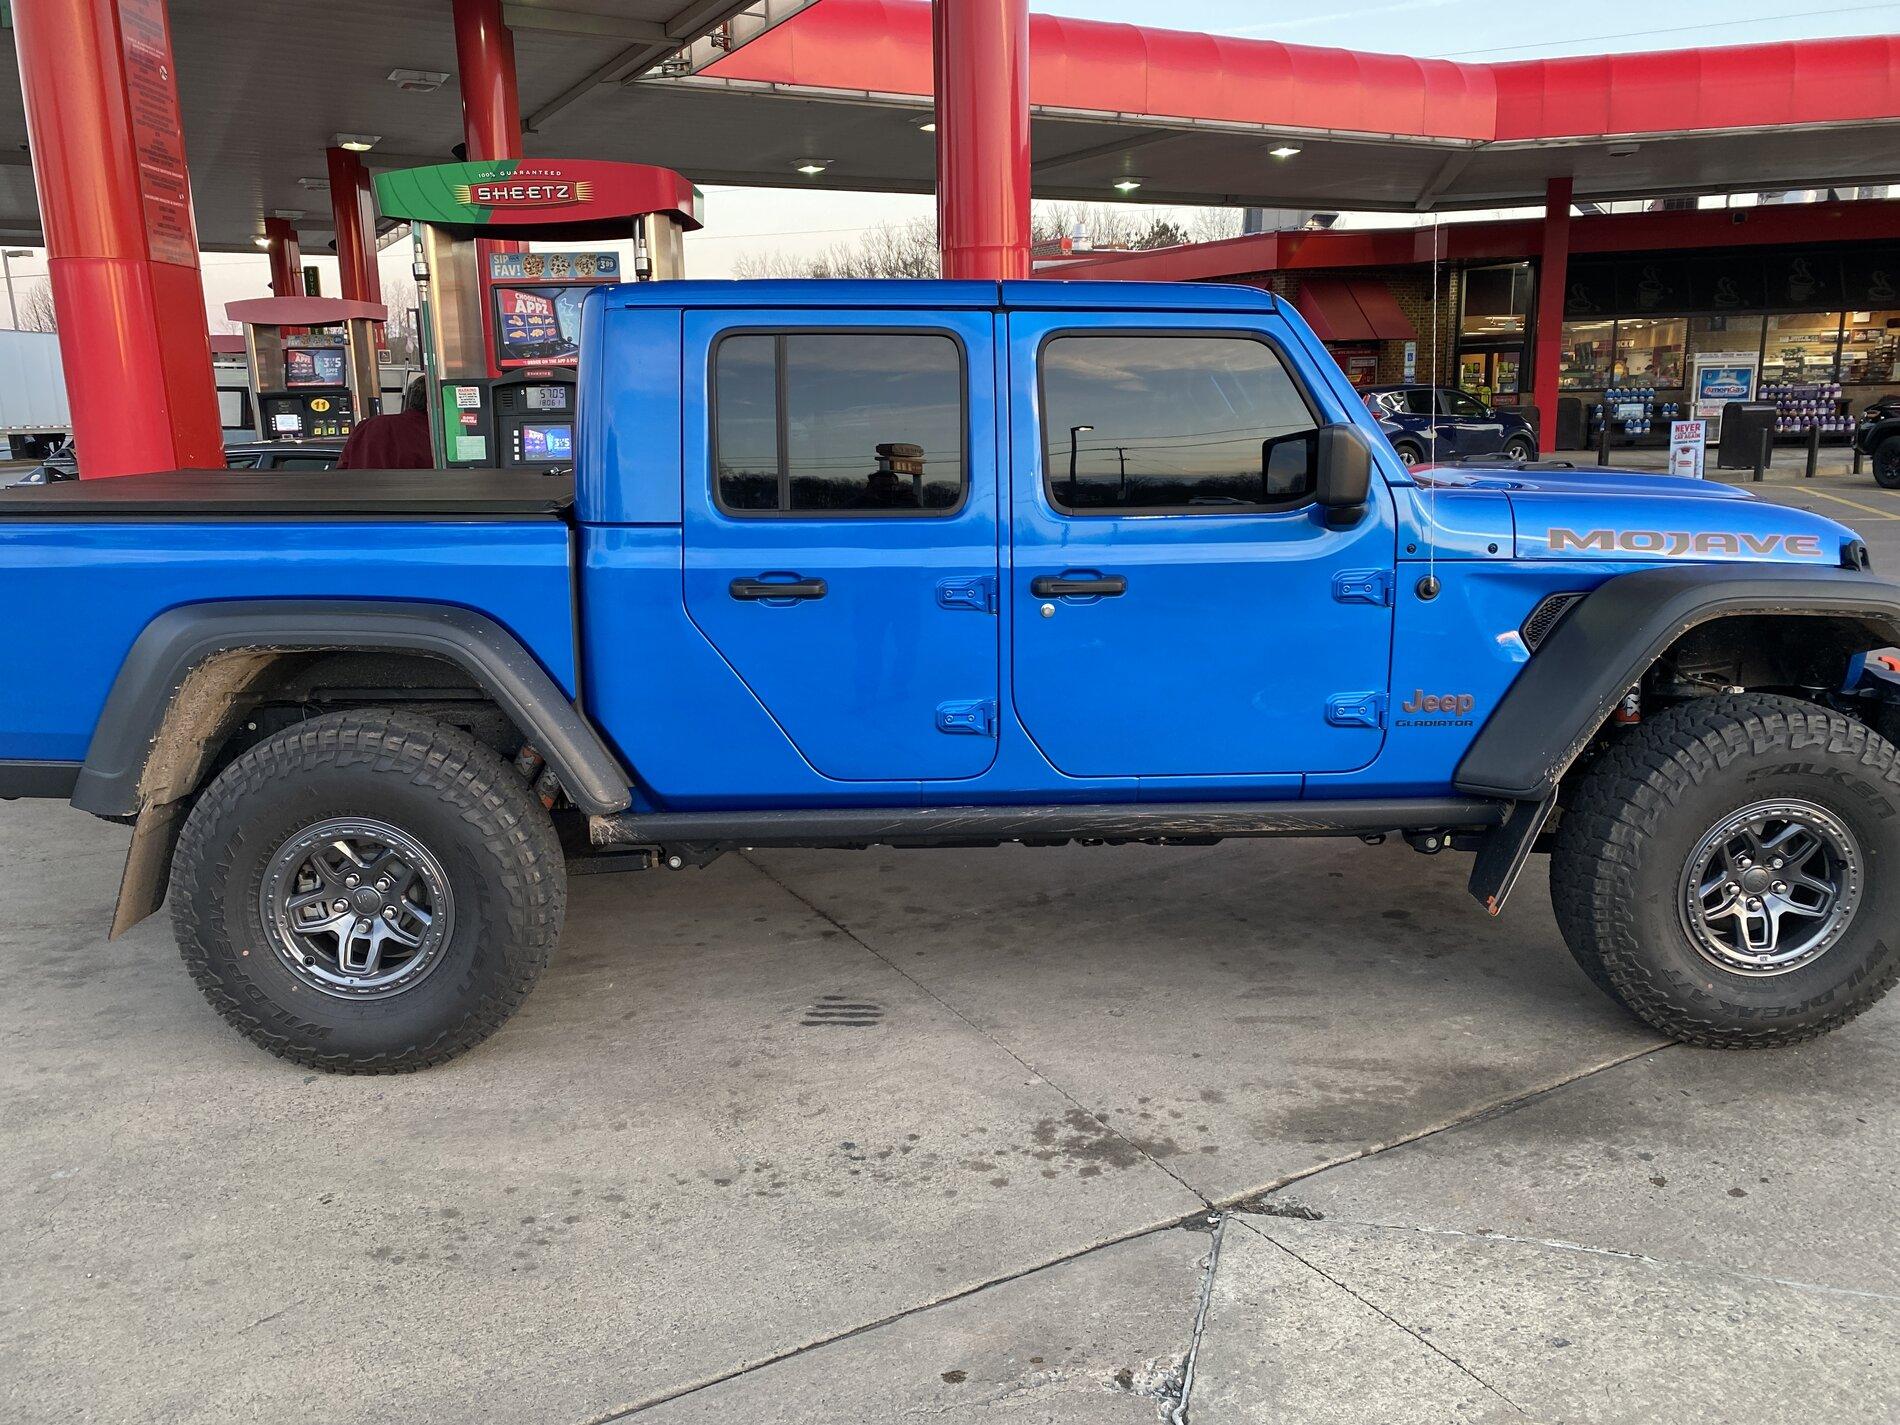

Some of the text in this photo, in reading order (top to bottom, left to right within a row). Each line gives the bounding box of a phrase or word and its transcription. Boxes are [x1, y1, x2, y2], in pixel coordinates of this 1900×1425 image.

[500, 169, 562, 177] GUARANTEED
[477, 185, 569, 200] SHEETZ
[493, 255, 508, 264] SIP
[494, 265, 521, 277] FAV!
[515, 299, 549, 315] APPZ
[1704, 386, 1745, 396] AmeriGas
[314, 401, 326, 410] 11
[1675, 423, 1701, 432] NEVER
[1547, 527, 1823, 557] MOJAVE
[1402, 688, 1475, 718] Jeep
[208, 886, 334, 1040] WILDPEAK
